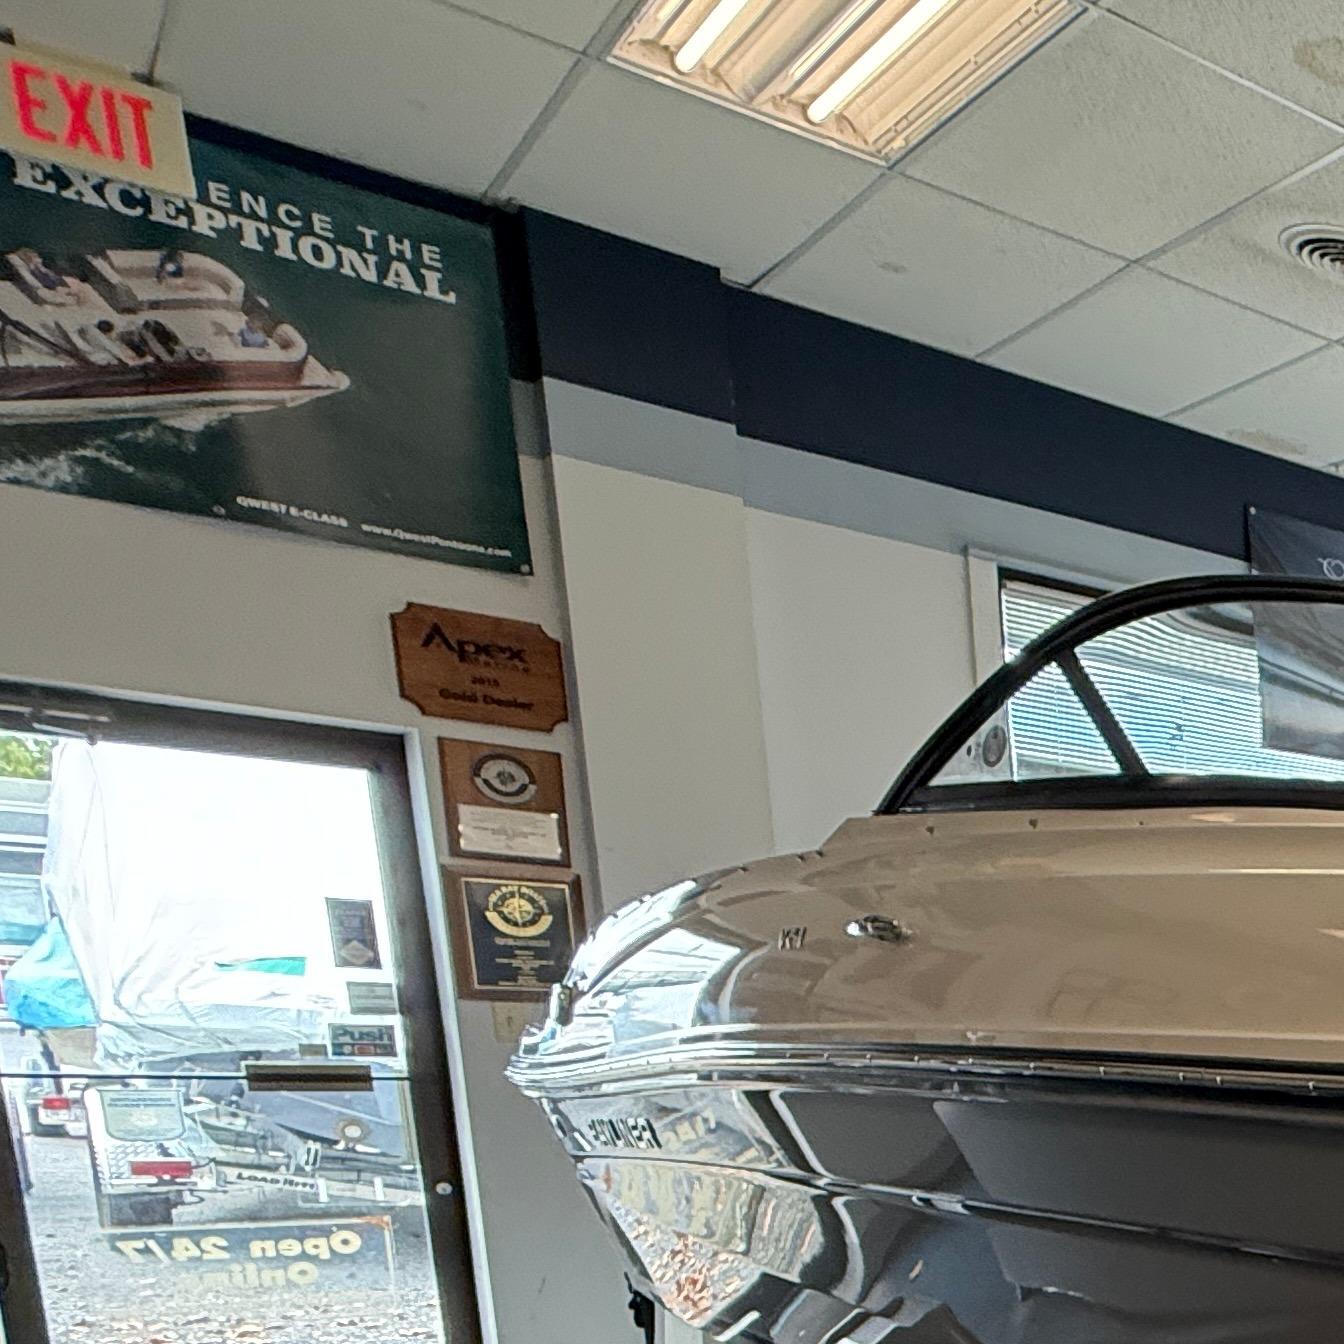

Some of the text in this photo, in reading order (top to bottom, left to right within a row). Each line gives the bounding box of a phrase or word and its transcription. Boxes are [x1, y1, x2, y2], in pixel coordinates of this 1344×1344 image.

[9, 59, 153, 170] EXIT
[13, 153, 456, 304] EXCEPTIONAL
[357, 225, 443, 268] THE
